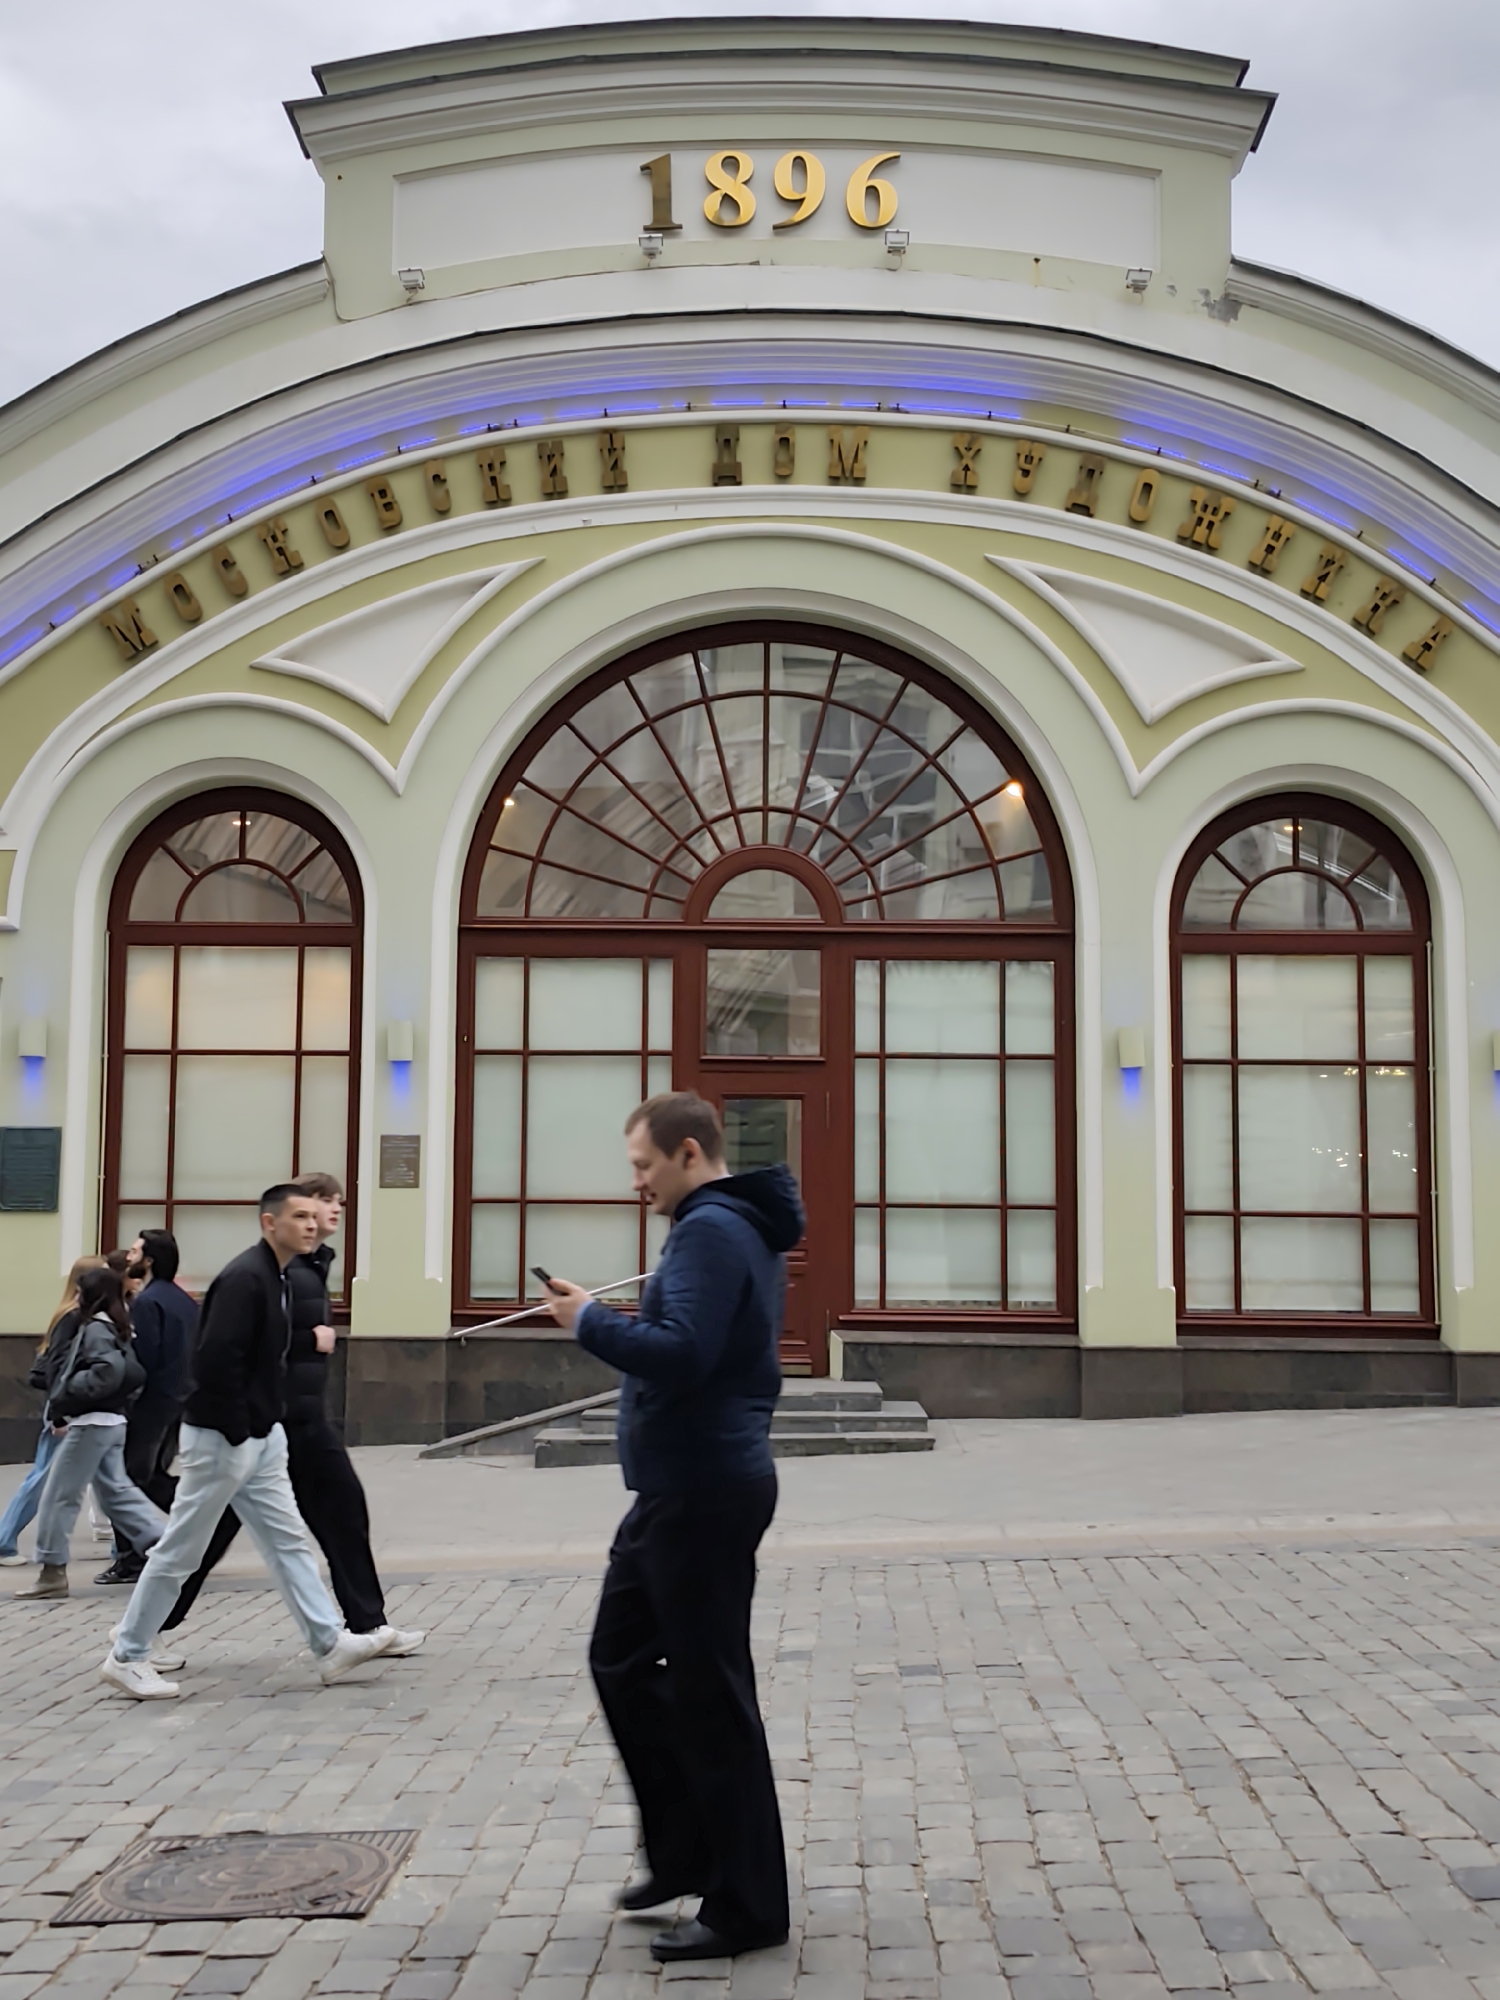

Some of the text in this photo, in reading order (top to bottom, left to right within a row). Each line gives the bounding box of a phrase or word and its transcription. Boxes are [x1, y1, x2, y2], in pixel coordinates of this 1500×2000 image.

[639, 150, 901, 230] 1896
[712, 424, 870, 487] ДОМ
[950, 432, 1455, 671] ХУДОЖНИКА
